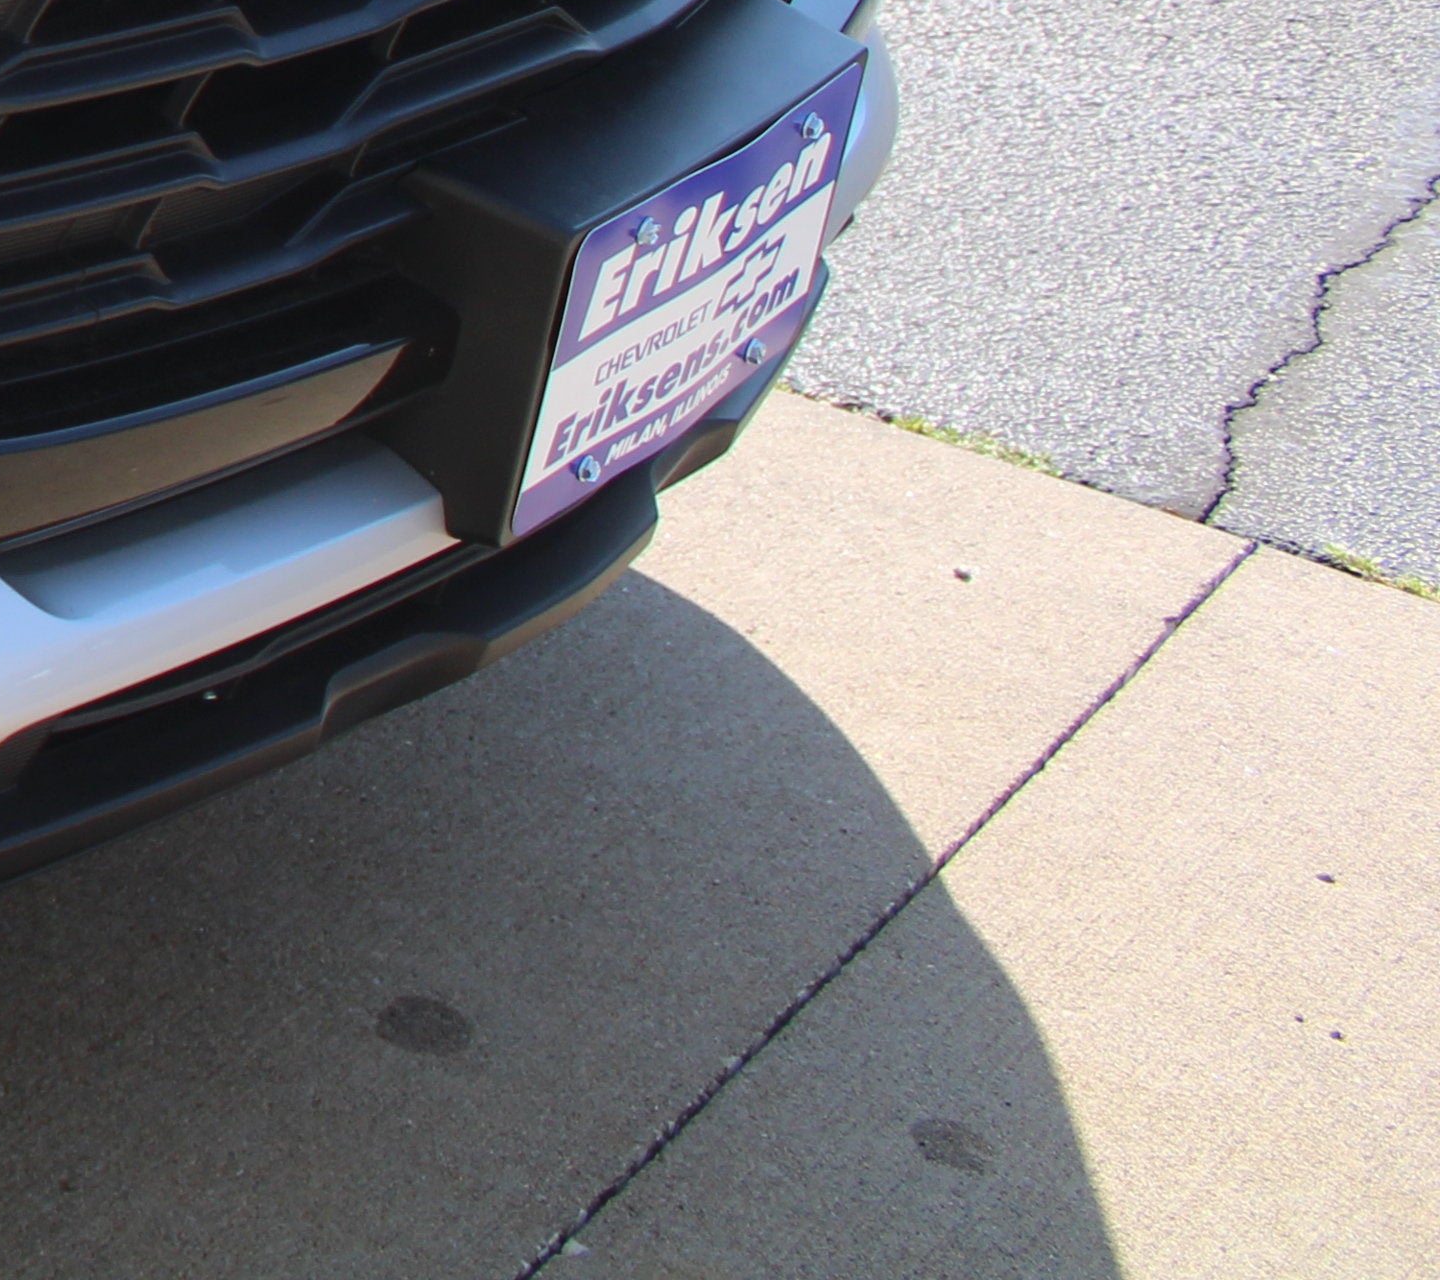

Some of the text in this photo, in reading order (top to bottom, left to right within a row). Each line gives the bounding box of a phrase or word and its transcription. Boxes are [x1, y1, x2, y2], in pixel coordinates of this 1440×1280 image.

[578, 132, 832, 342] Eriksen
[543, 265, 799, 470] Eriksens.com
[594, 301, 712, 386] CHEVROLET
[604, 362, 733, 467] MILAN, ILLINOIS
